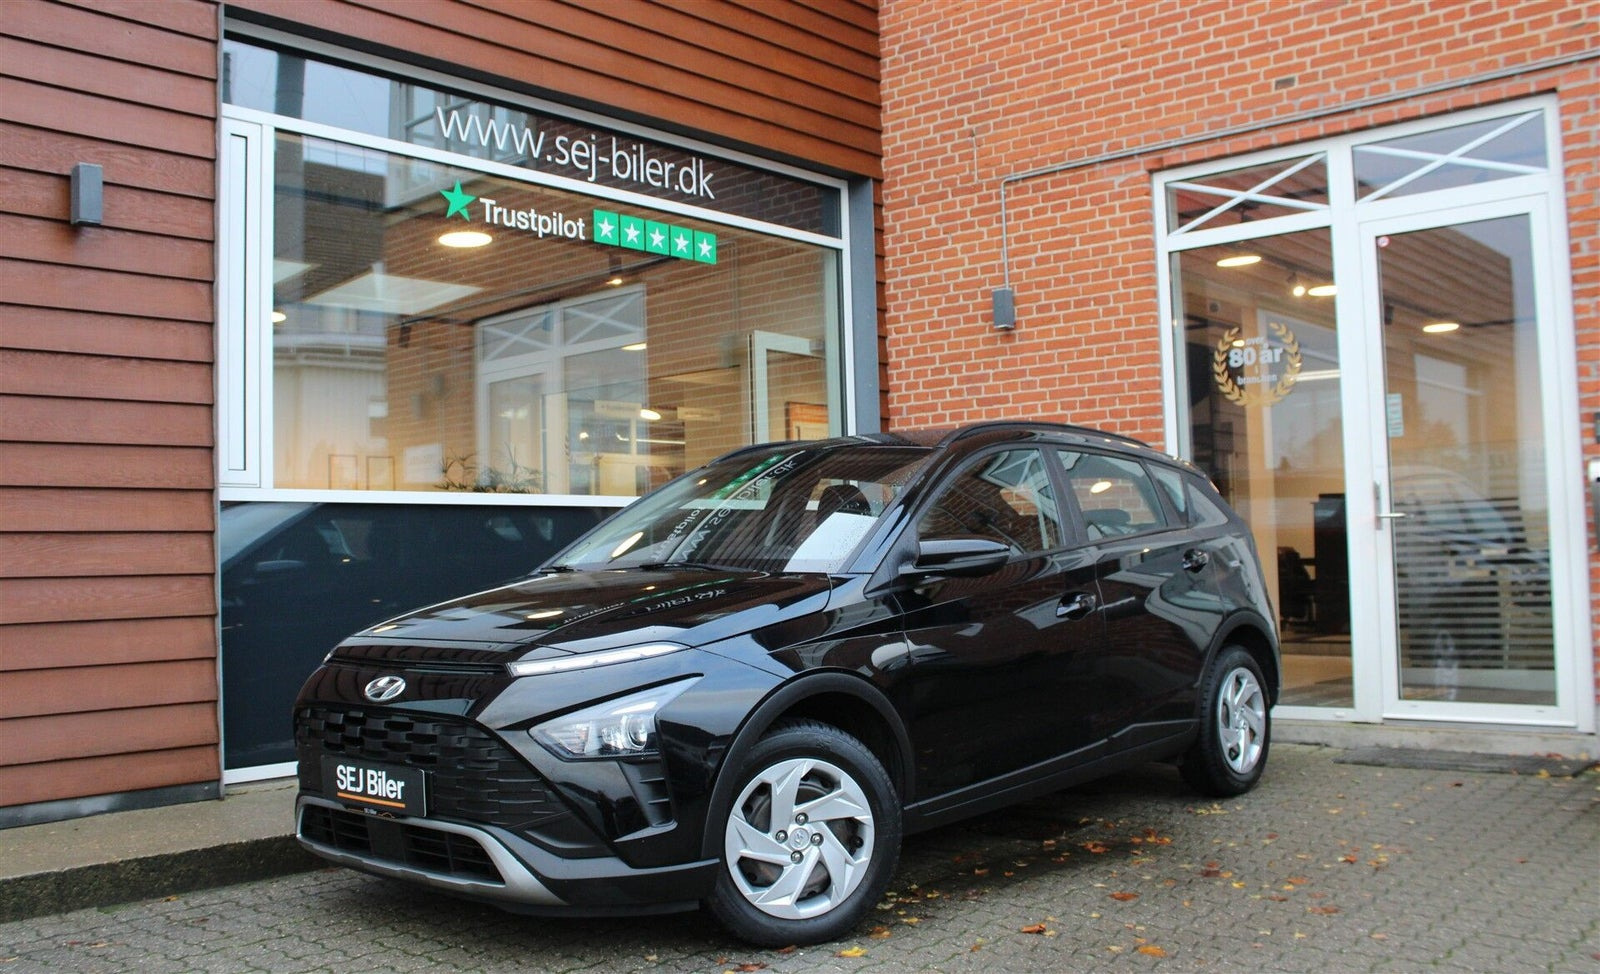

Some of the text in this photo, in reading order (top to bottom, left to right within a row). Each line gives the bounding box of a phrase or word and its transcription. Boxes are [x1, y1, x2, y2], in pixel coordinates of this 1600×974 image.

[436, 105, 716, 200] www.sej-biler.dk
[479, 197, 586, 241] Trustpilot
[1229, 343, 1283, 368] 80 år
[336, 764, 405, 799] SEJ Biler
